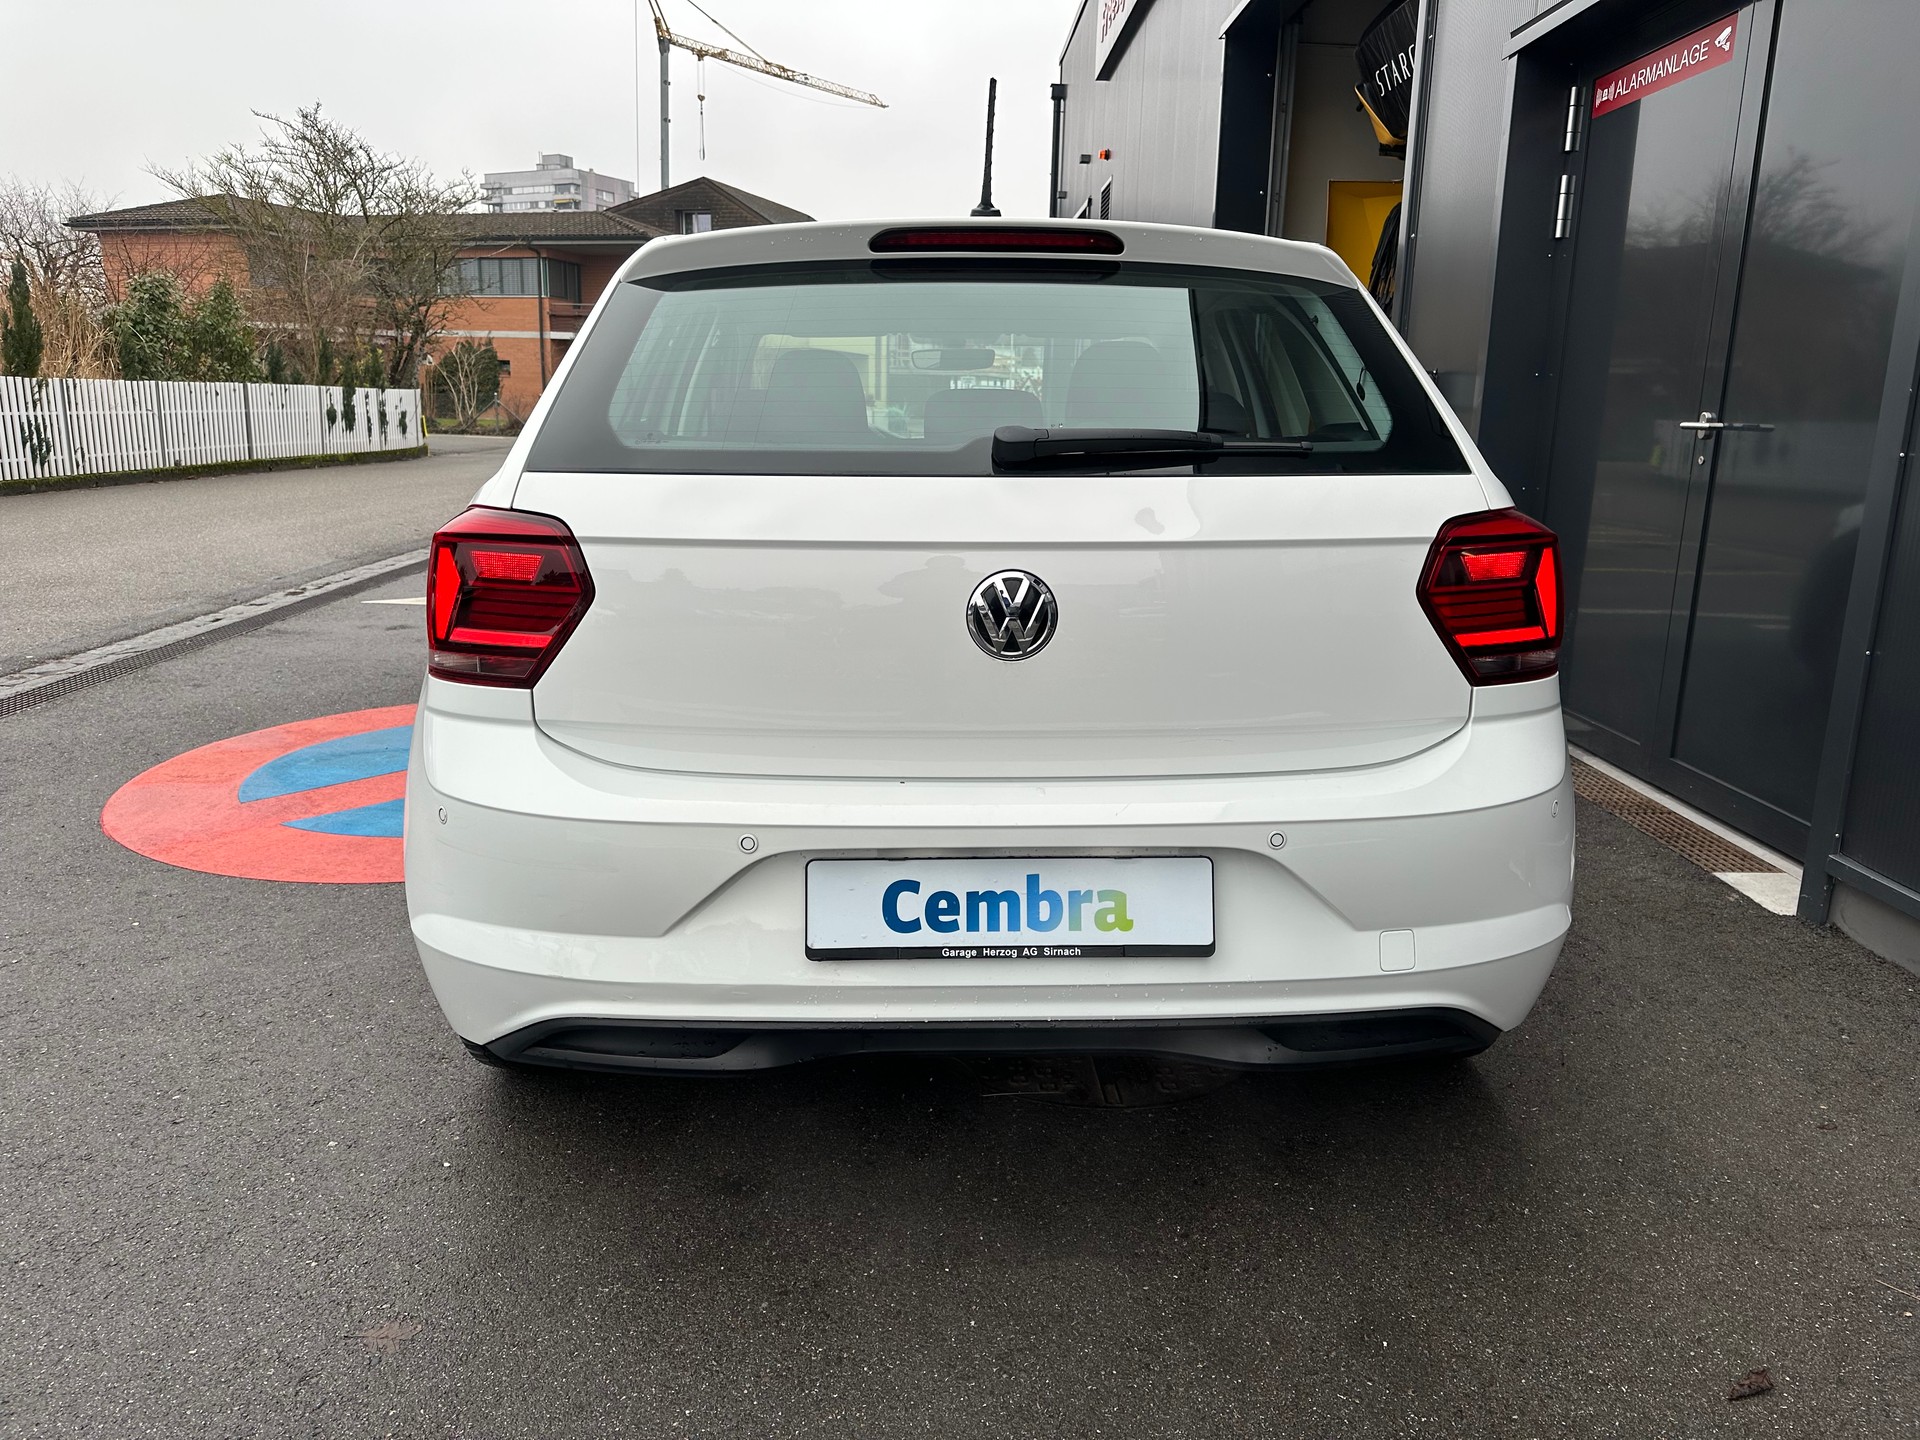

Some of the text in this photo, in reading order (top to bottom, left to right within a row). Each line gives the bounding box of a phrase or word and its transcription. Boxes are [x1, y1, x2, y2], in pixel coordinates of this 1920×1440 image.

[1614, 38, 1710, 98] ALARMANLAGE
[968, 571, 1056, 658] VW
[881, 873, 1134, 934] Cembra
[941, 947, 1081, 959] Garage Herzog AG Sirnach
